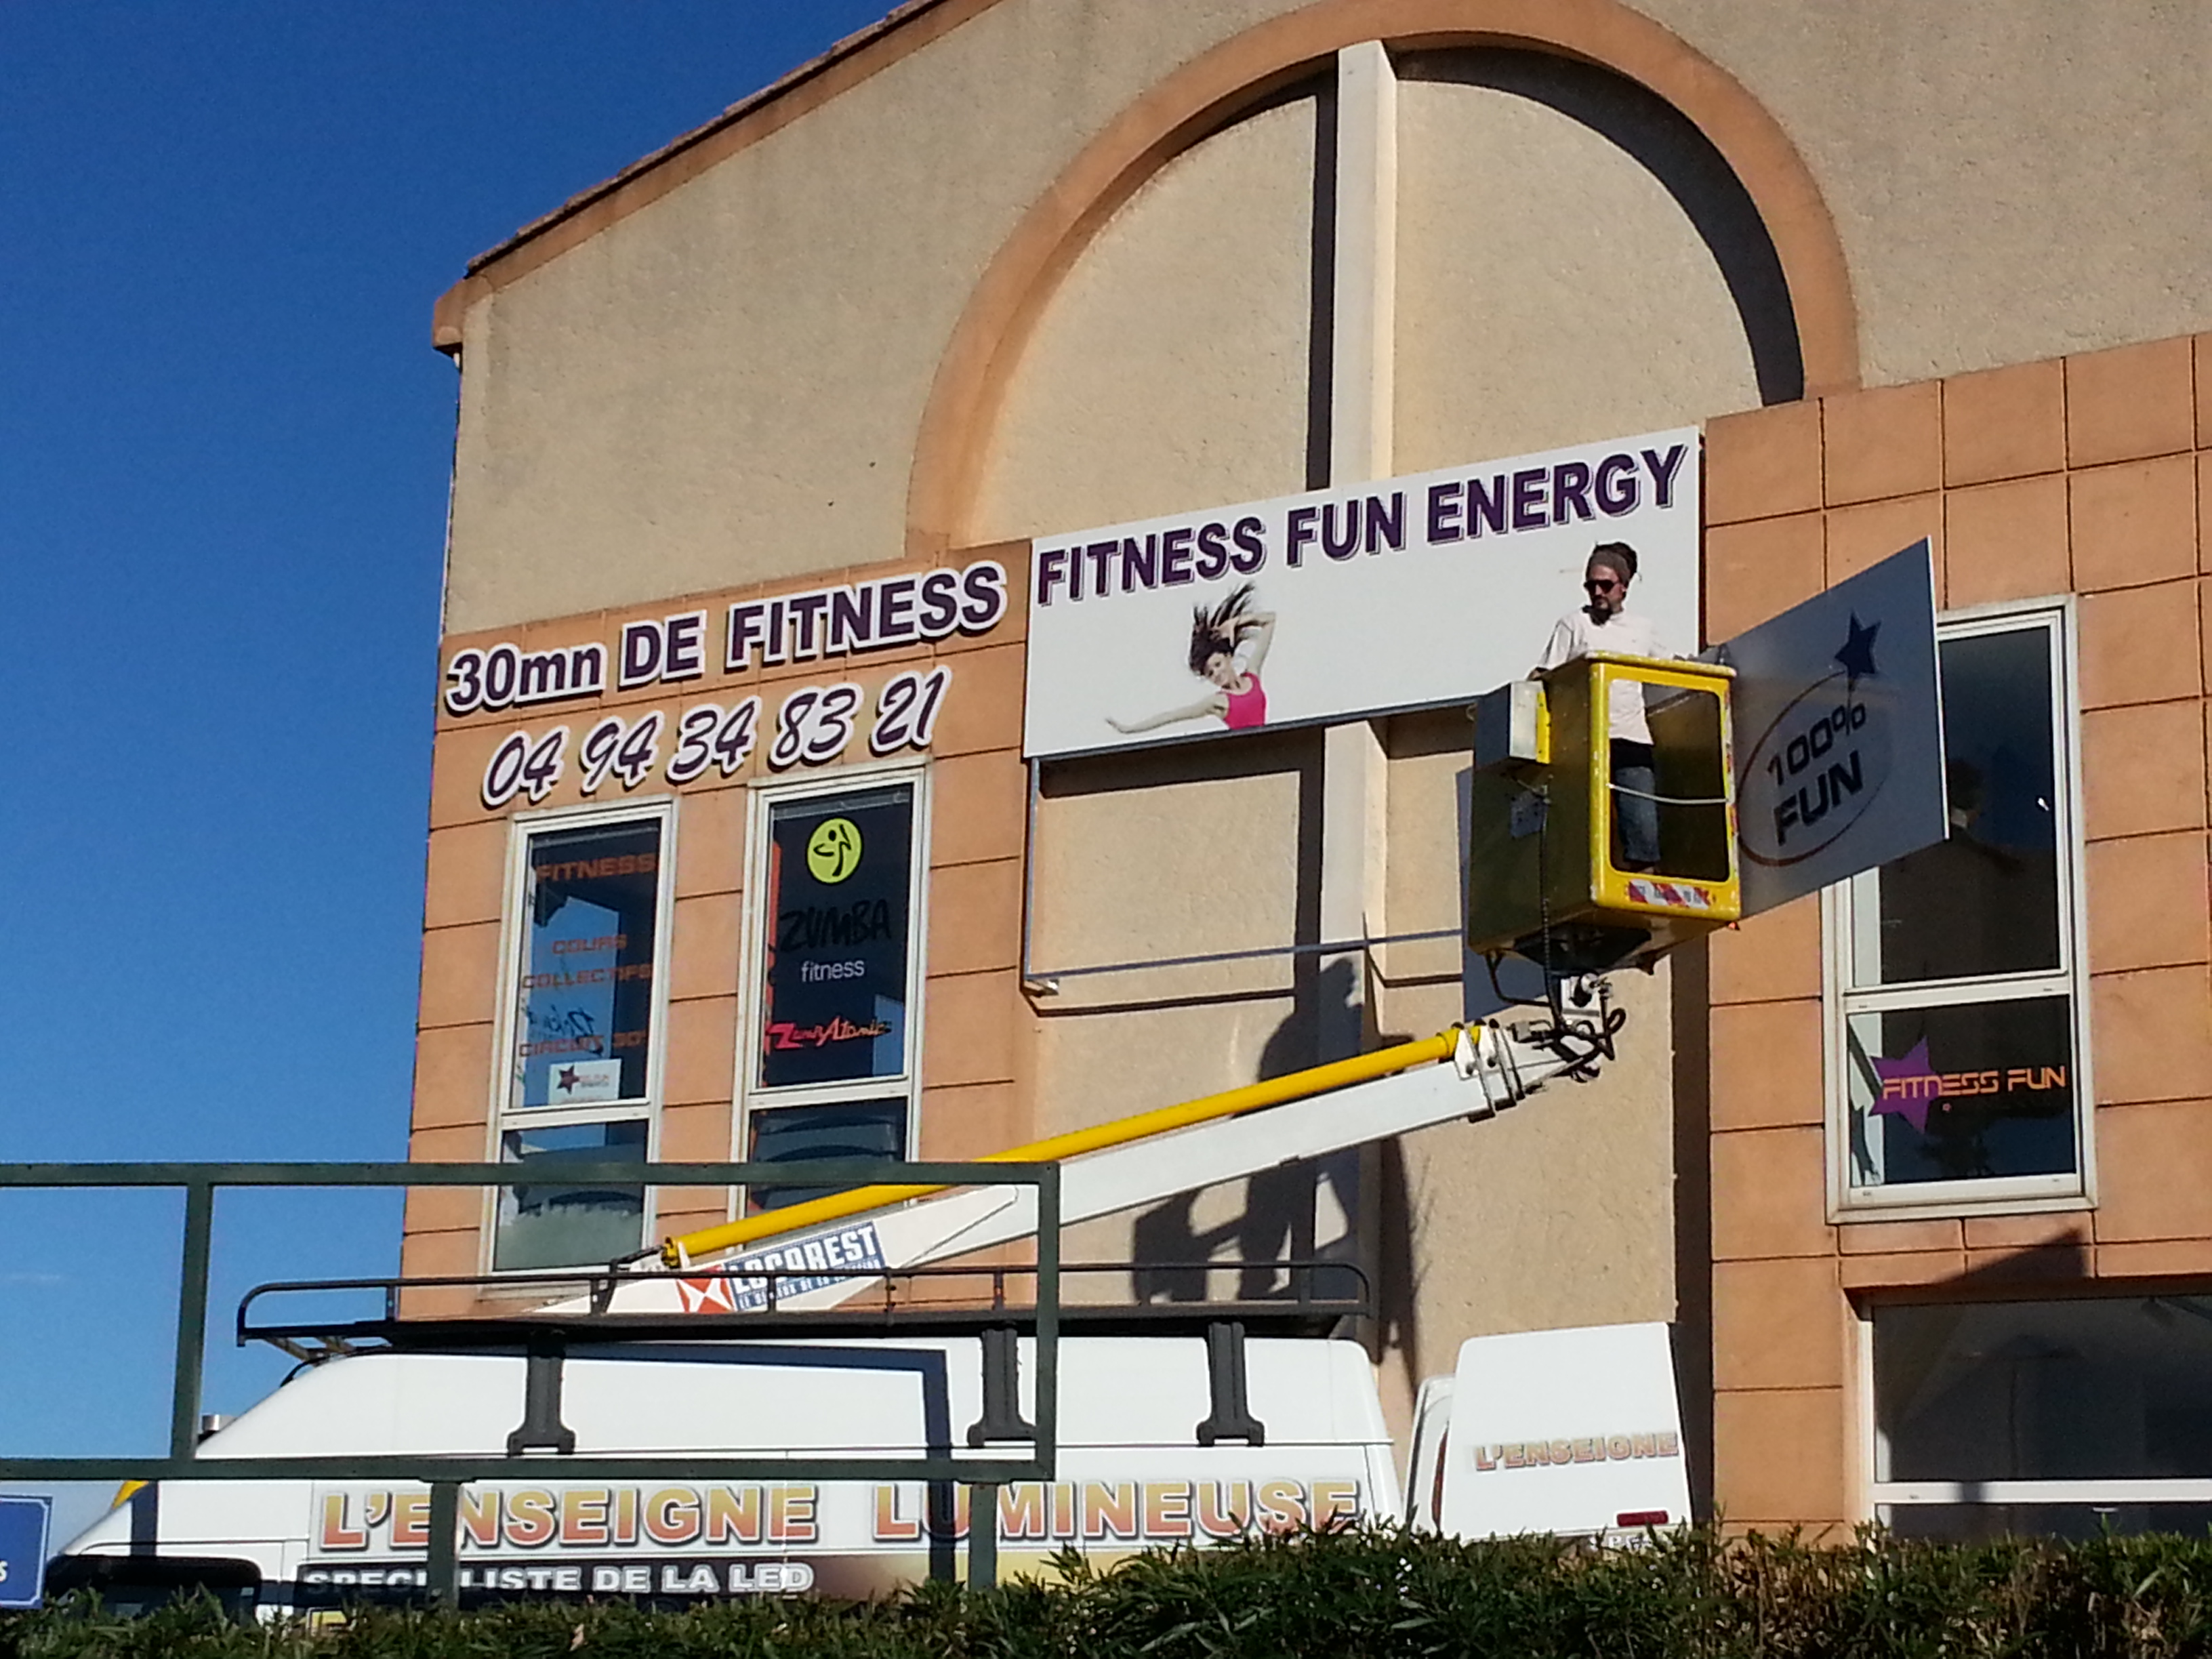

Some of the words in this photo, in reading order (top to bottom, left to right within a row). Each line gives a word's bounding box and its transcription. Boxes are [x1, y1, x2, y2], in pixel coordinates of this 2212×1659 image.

[1038, 517, 1266, 606] FITNESS
[1286, 492, 1406, 567] FUN
[1427, 444, 1687, 544] ENERGY
[447, 644, 607, 712] 30mn
[620, 611, 706, 686] DE
[726, 562, 1006, 668] FITNESS
[483, 727, 568, 805] 04
[581, 711, 664, 792] 94
[668, 697, 760, 781] 34
[769, 684, 862, 768] 83
[871, 666, 951, 754] 21
[1767, 703, 1866, 785] 100%
[1773, 750, 1863, 846] FUN
[536, 853, 656, 882] FITNESS
[552, 935, 628, 954] COURS
[779, 899, 892, 952] ZUMBA
[801, 960, 865, 983] fitness
[1883, 1070, 1999, 1100] FITNESS
[2007, 1065, 2066, 1092] FUN
[1475, 1431, 1679, 1471] L'ENSEIGNE
[320, 1486, 817, 1551] L'ENSEIGNE
[873, 1479, 1359, 1540] LUMINEUSE
[304, 1567, 581, 1593] SPECILISTE
[591, 1565, 651, 1593] DE
[661, 1565, 718, 1593] LA
[727, 1562, 815, 1593] LED
